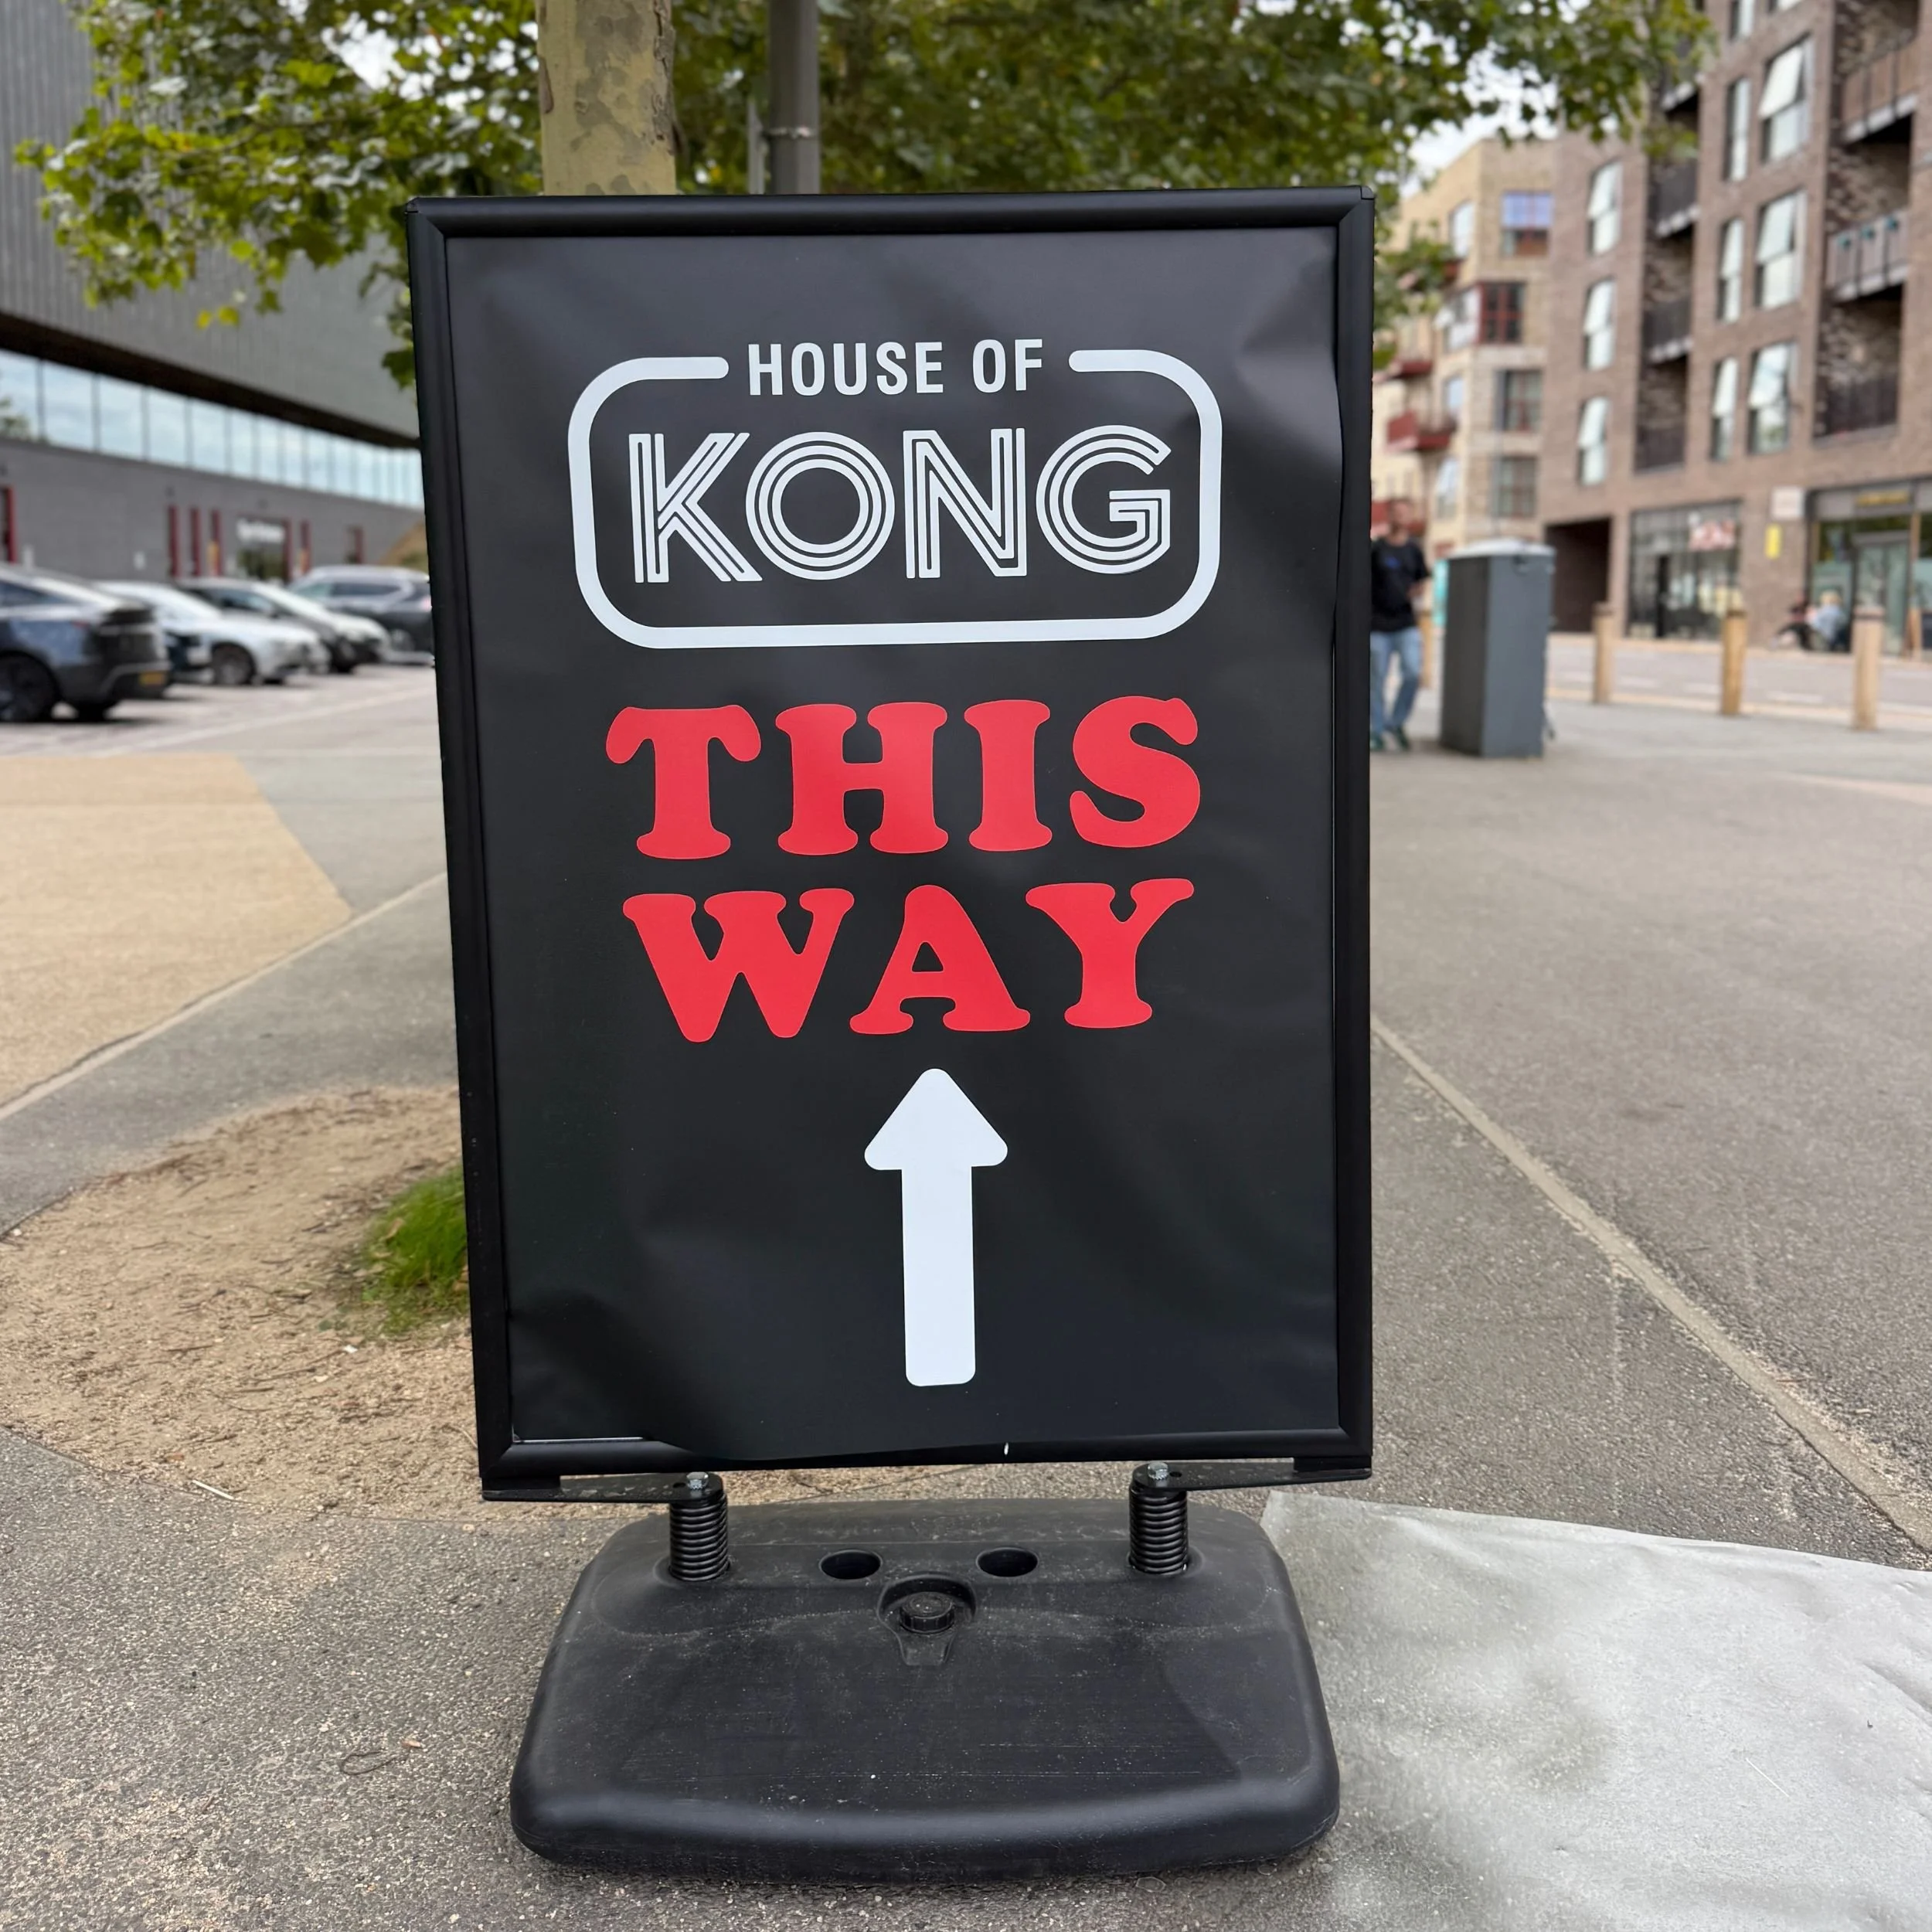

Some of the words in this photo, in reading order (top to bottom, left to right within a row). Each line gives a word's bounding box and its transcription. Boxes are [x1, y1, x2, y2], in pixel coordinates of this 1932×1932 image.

[748, 341, 944, 396] HOUSE
[972, 338, 1043, 393] OF
[628, 424, 1172, 583] KONG
[605, 695, 1201, 860] THIS
[622, 877, 1195, 1043] WAY
